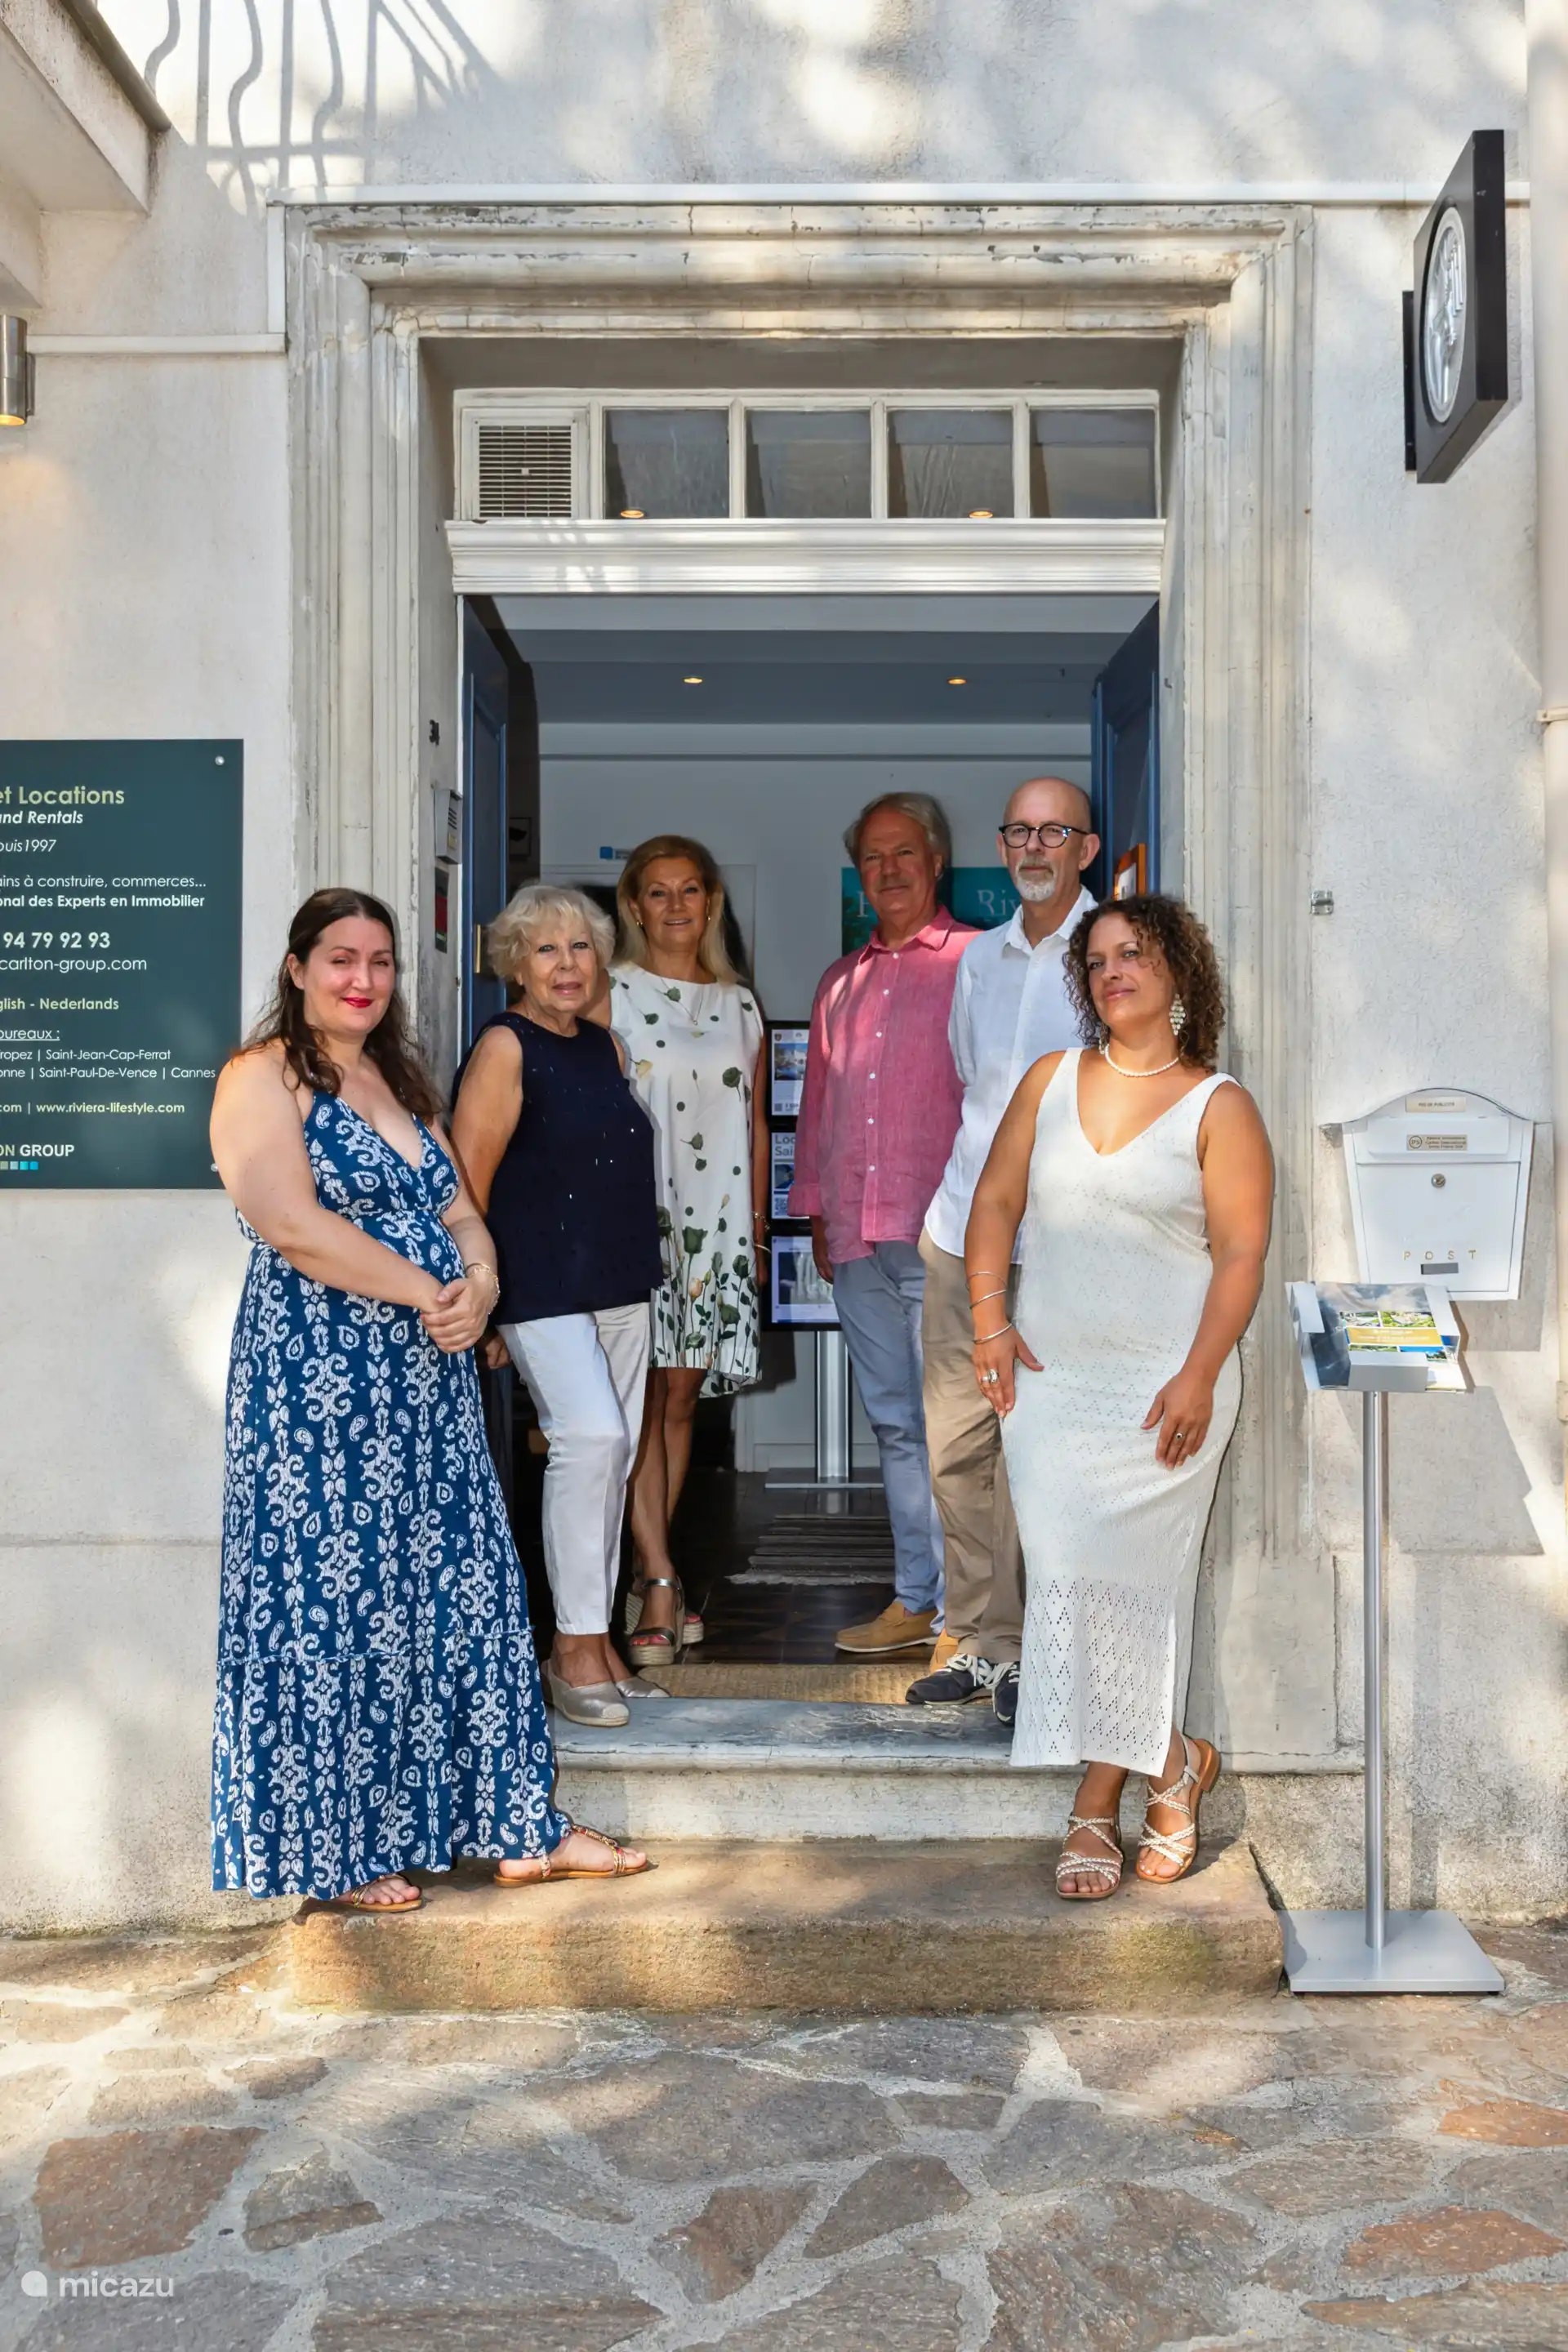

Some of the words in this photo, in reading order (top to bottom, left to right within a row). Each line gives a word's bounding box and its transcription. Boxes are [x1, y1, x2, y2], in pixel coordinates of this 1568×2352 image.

[19, 785, 125, 805] Locations
[0, 810, 24, 824] nd
[27, 810, 83, 824] Rentals
[0, 875, 20, 888] ins
[24, 874, 33, 888] à
[37, 875, 108, 889] construire,
[112, 877, 207, 888] commerces...
[0, 894, 24, 907] nal
[28, 894, 54, 907] des
[57, 894, 106, 910] Experts
[109, 897, 127, 907] en
[131, 894, 205, 907] Immobilier
[2, 931, 25, 948] 94
[31, 931, 54, 949] 79
[60, 932, 82, 948] 92
[88, 931, 110, 949] 93
[39, 997, 119, 1010] Nederlands
[0, 1049, 33, 1062] ropez
[46, 1049, 172, 1062] Saint-Jean-Cap-Ferrat
[0, 1069, 26, 1078] nne
[38, 1067, 158, 1079] Saint-Paul-De-Vence
[171, 1067, 216, 1079] Cannes
[0, 1104, 22, 1113] om
[36, 1102, 185, 1116] www.riviera-lifestyle.com
[19, 1144, 75, 1157] GROUP
[1403, 1250, 1476, 1260] POST
